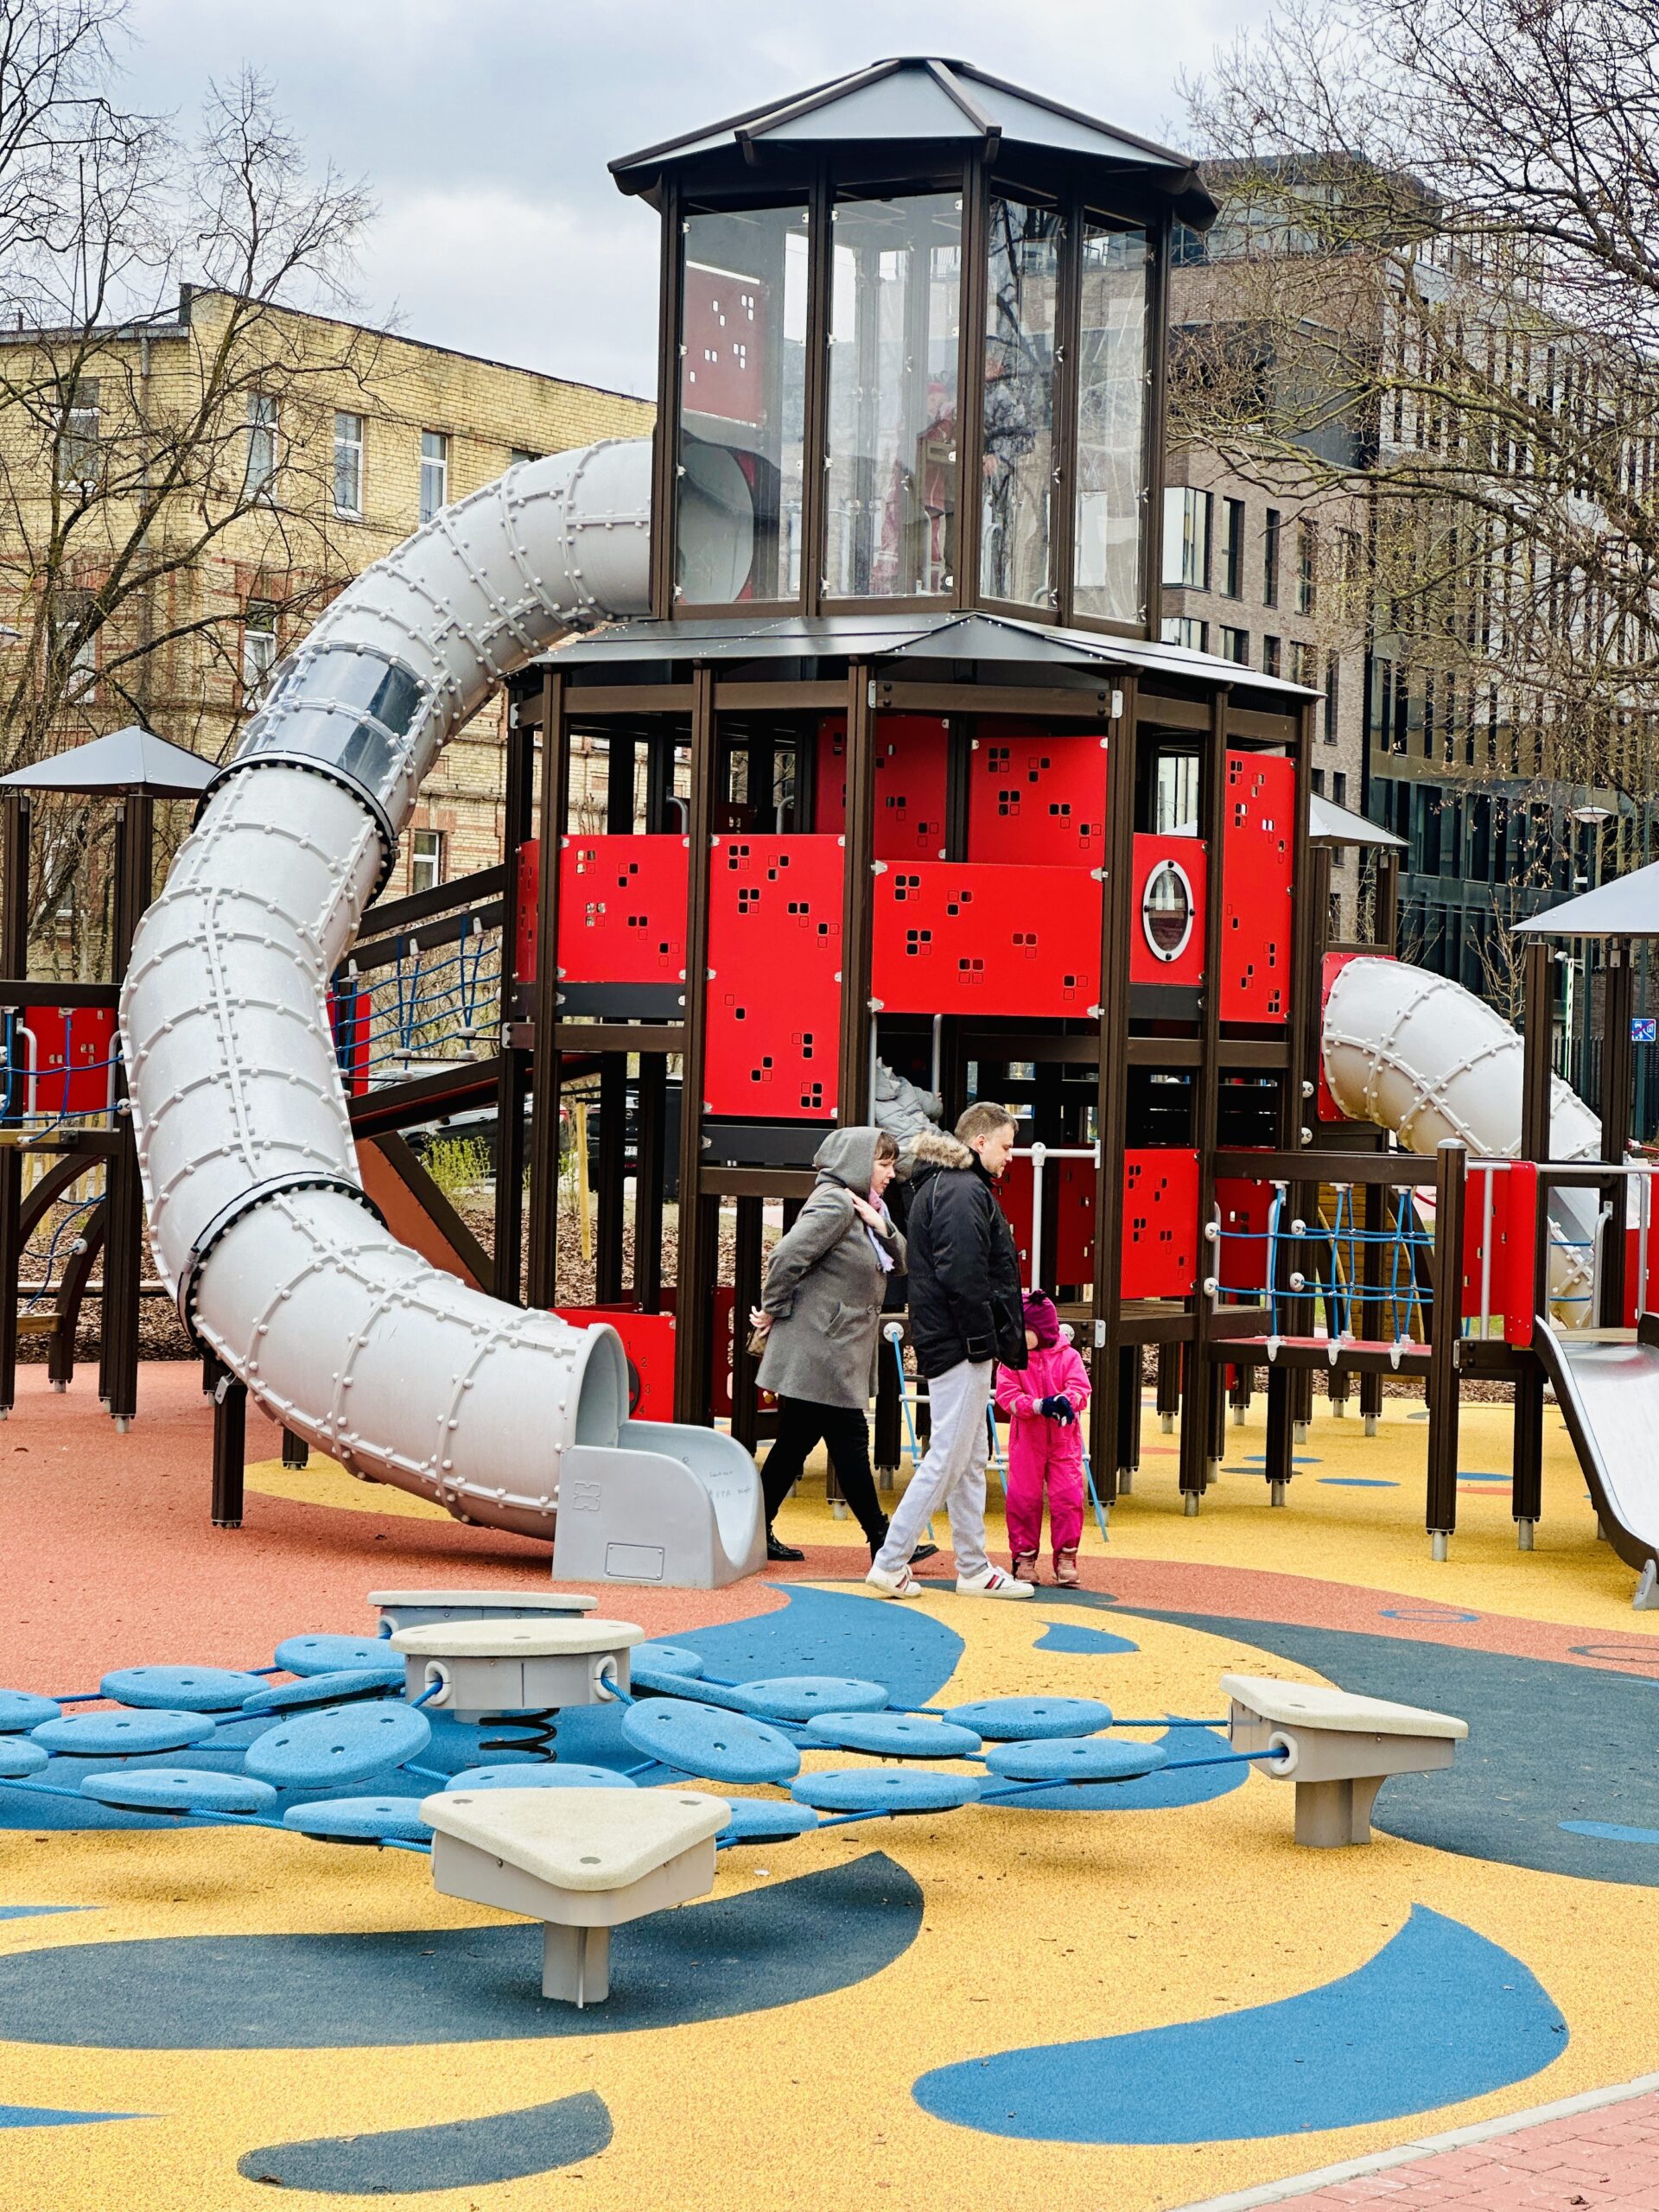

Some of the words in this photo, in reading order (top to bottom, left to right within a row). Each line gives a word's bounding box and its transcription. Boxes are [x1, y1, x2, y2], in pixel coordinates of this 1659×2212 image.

[627, 1341, 632, 1351] 1
[641, 1357, 647, 1367] 2
[645, 1383, 651, 1395] 3
[639, 1405, 645, 1414] 4
